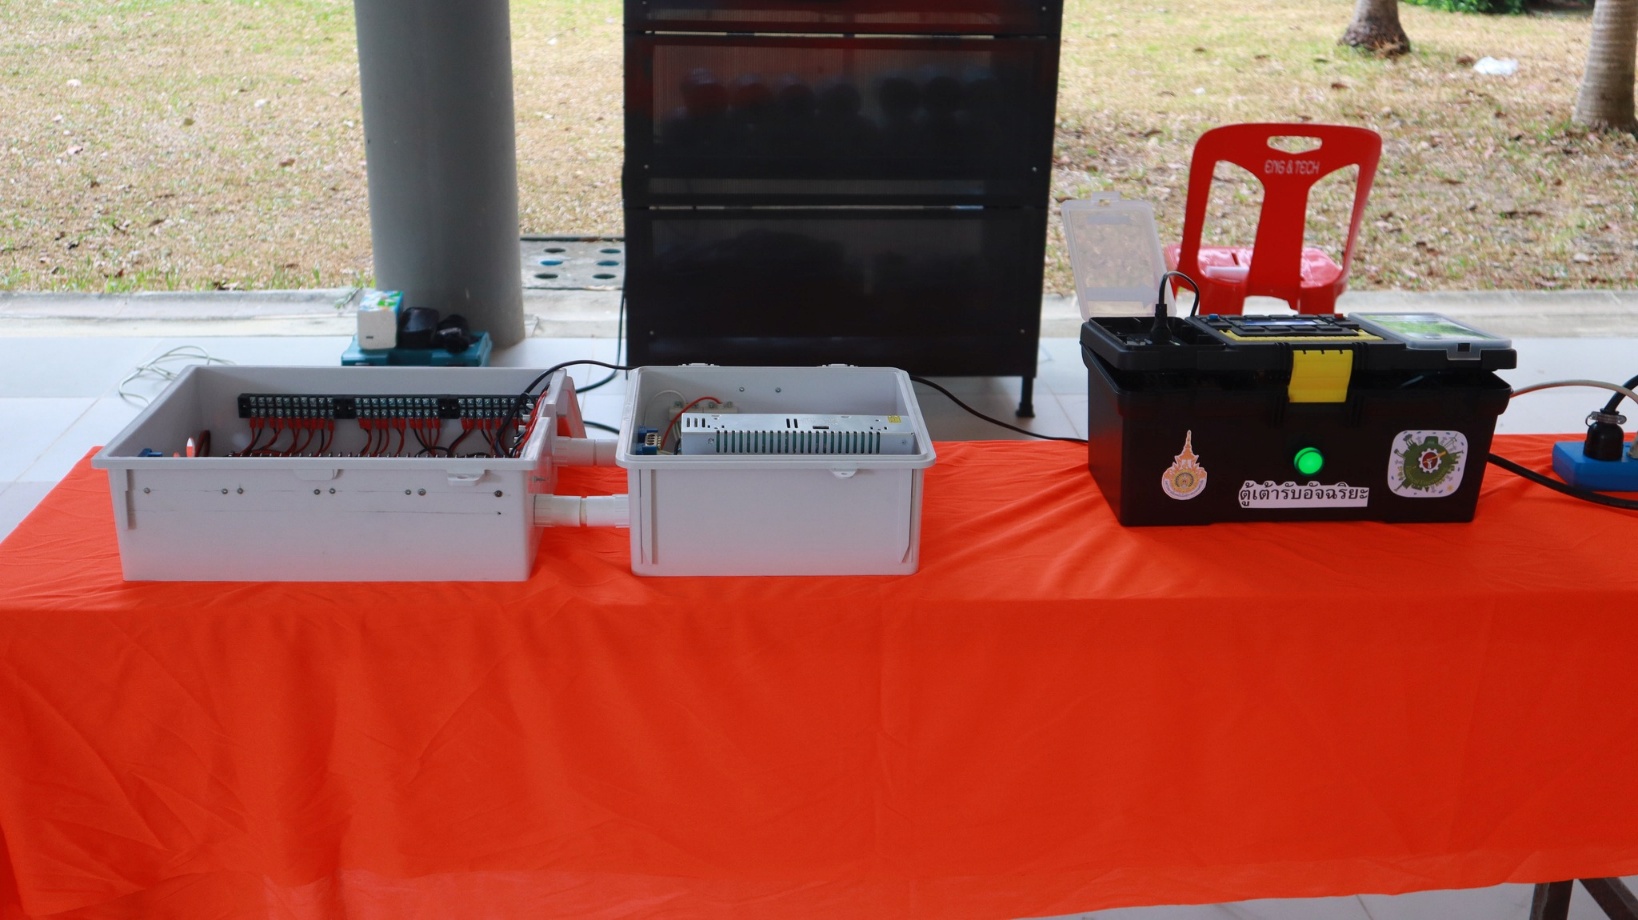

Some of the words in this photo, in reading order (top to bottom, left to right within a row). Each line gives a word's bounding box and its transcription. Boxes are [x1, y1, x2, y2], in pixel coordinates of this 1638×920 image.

[1286, 159, 1294, 174] &
[1295, 160, 1321, 175] TECH
[1240, 481, 1369, 507] ตู้เต้ารับอัจฉริยะ
